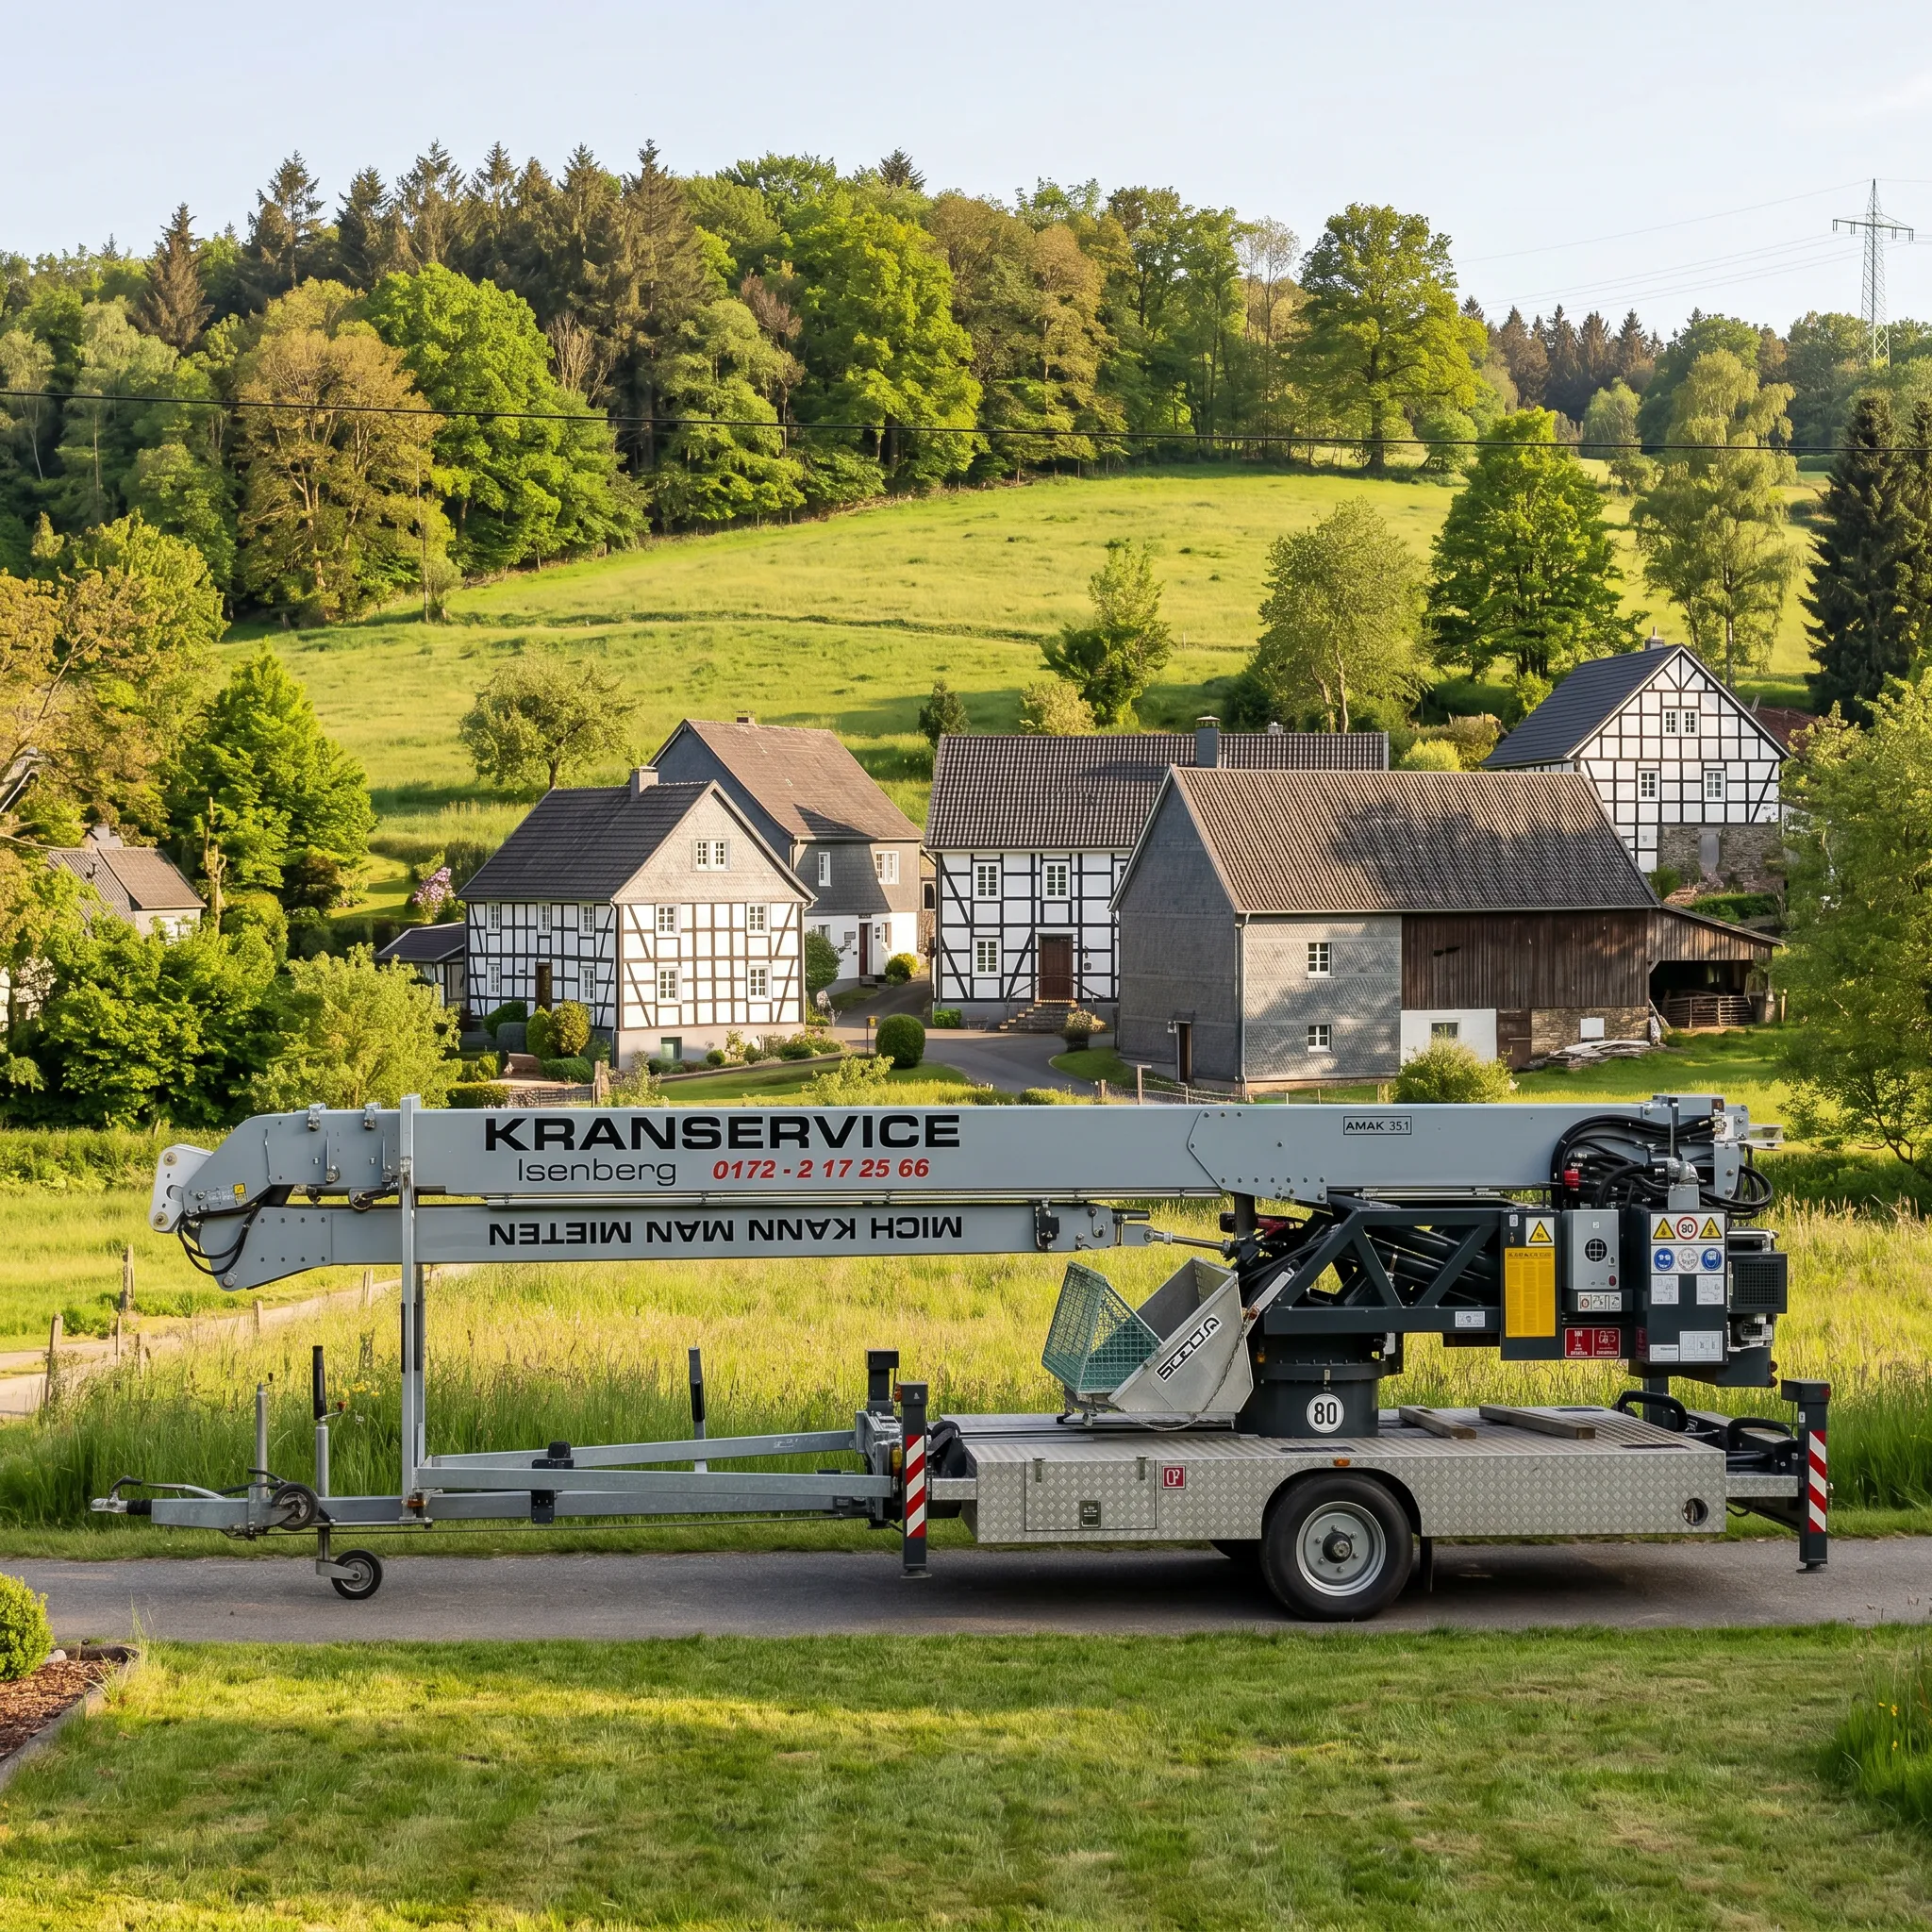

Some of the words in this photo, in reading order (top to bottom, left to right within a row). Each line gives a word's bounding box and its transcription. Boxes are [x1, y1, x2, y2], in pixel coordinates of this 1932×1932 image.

[485, 1114, 960, 1151] KRANSERVICE
[1345, 1121, 1385, 1131] AMAK
[1389, 1121, 1409, 1131] 35.1
[518, 1158, 676, 1186] Isenberg
[712, 1159, 776, 1179] 0172
[796, 1158, 814, 1179] 2
[822, 1158, 853, 1178] 17
[858, 1158, 891, 1178] 25
[898, 1158, 930, 1178] 66
[489, 1222, 632, 1246] MIETEN
[645, 1220, 734, 1243] MAN
[747, 1218, 856, 1241] KANN
[870, 1216, 962, 1240] MICH
[1313, 1401, 1338, 1425] 80
